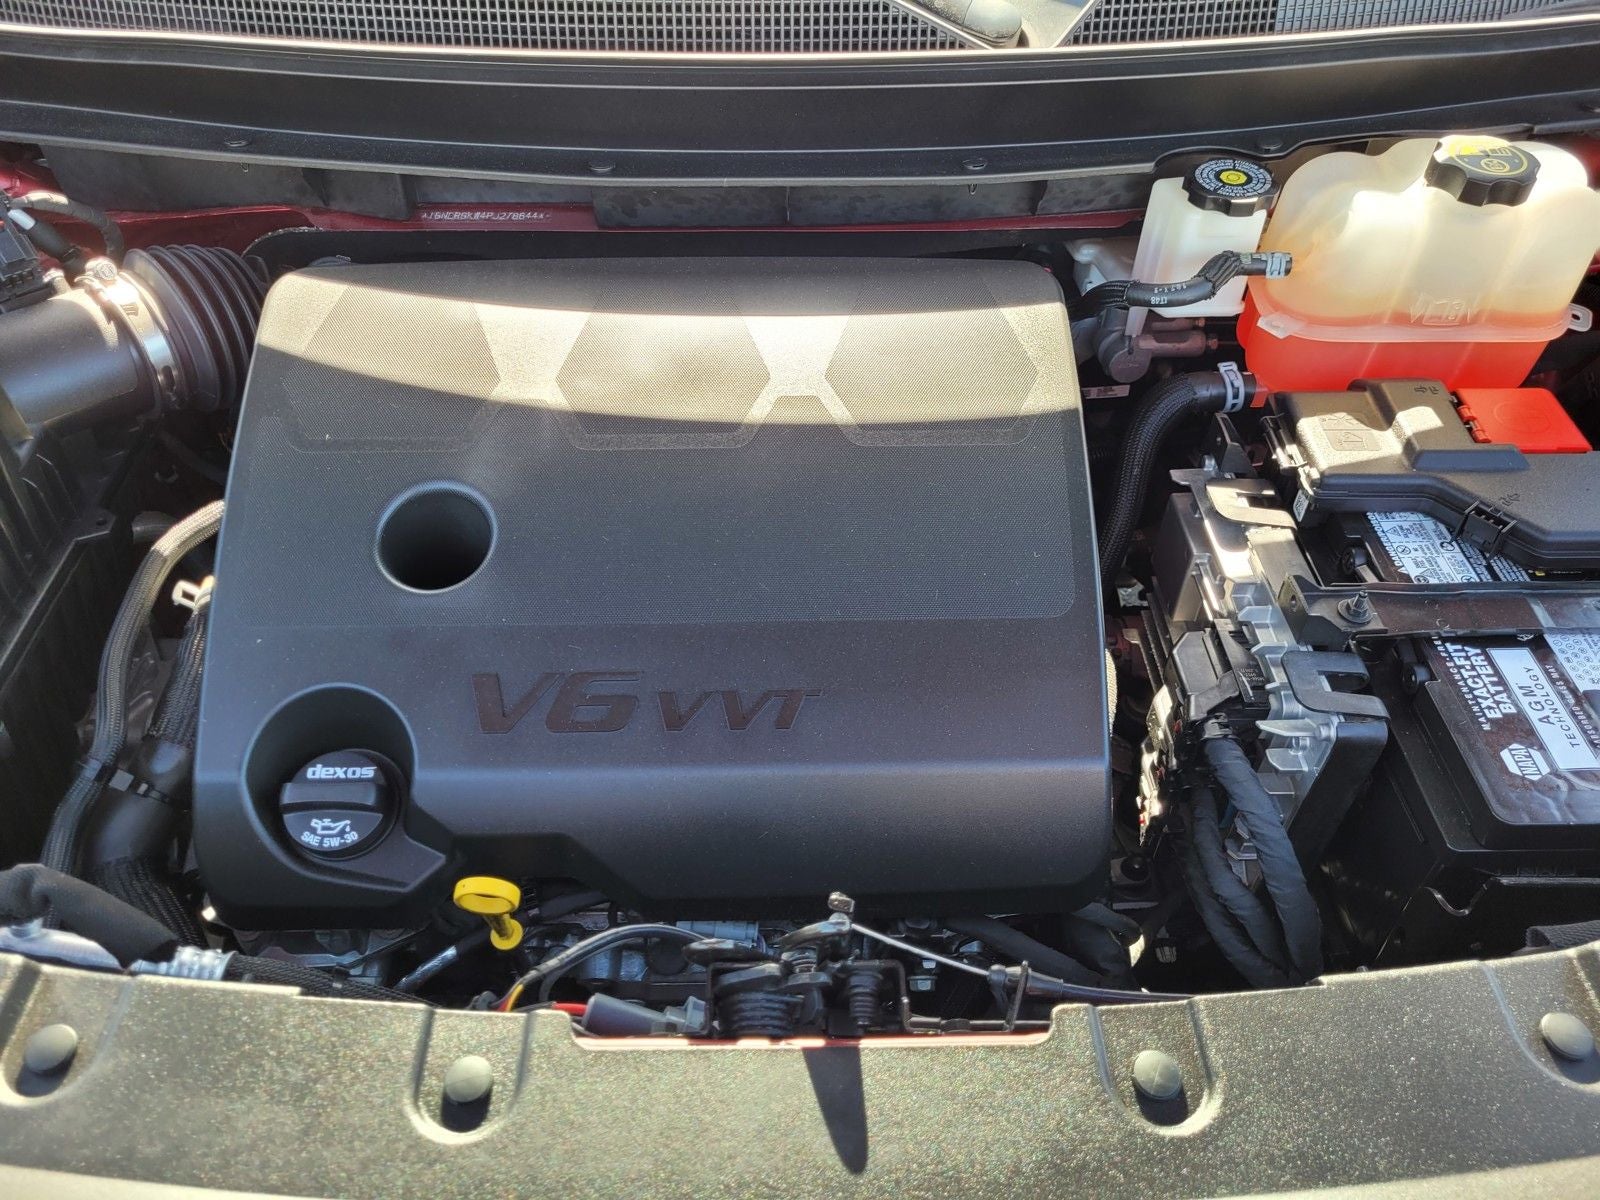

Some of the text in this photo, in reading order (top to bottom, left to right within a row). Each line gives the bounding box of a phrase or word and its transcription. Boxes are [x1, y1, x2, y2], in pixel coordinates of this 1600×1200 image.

[1445, 642, 1503, 719] EXACT-FIT
[1464, 646, 1517, 714] BATTERY
[1544, 664, 1560, 680] MAT
[472, 671, 822, 733] V6 VVT
[1524, 666, 1580, 748] TECHNOLOGY
[306, 764, 377, 779] dexos
[1508, 748, 1542, 776] NAPA
[301, 831, 358, 847] SAE 5W-30
